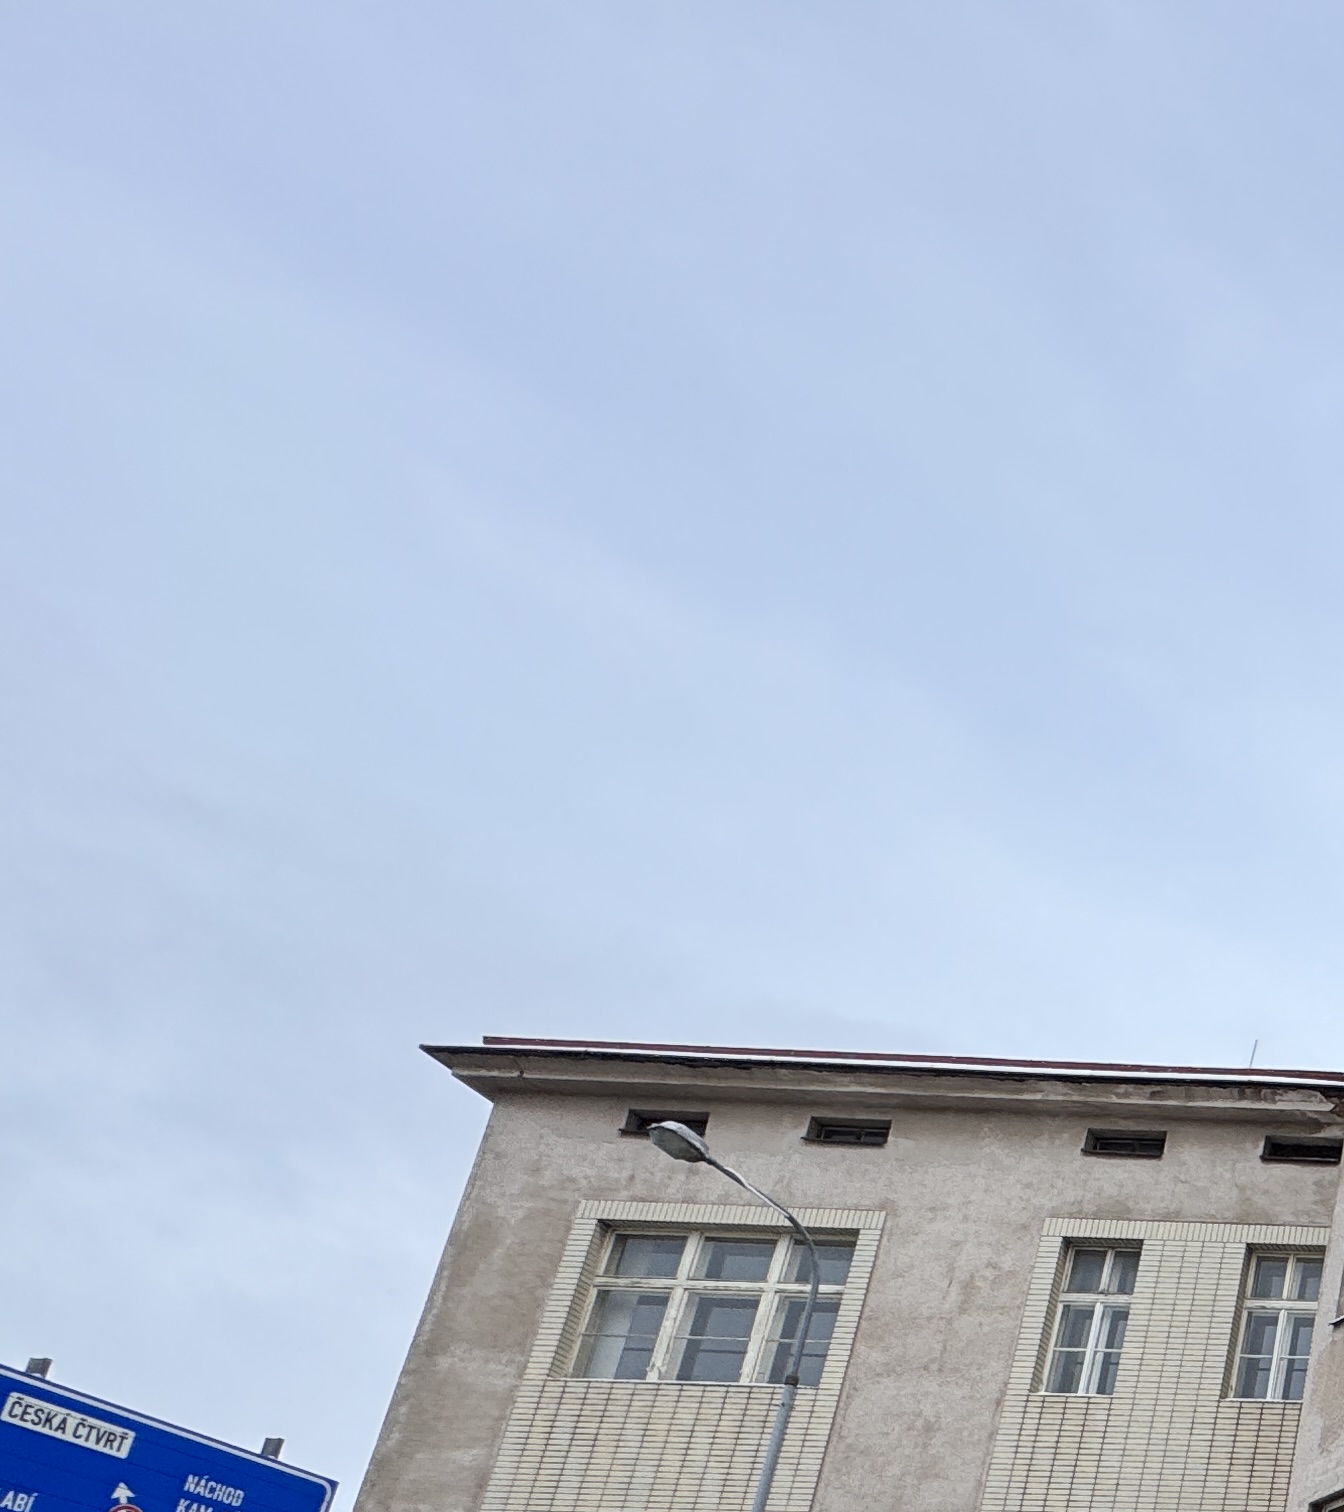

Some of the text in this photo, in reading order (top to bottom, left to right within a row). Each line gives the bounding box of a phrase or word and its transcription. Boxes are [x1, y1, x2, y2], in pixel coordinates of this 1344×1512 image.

[8, 1397, 129, 1453] ČESKÁ ČTVRŤ
[183, 1474, 245, 1507] NÁCHOD
